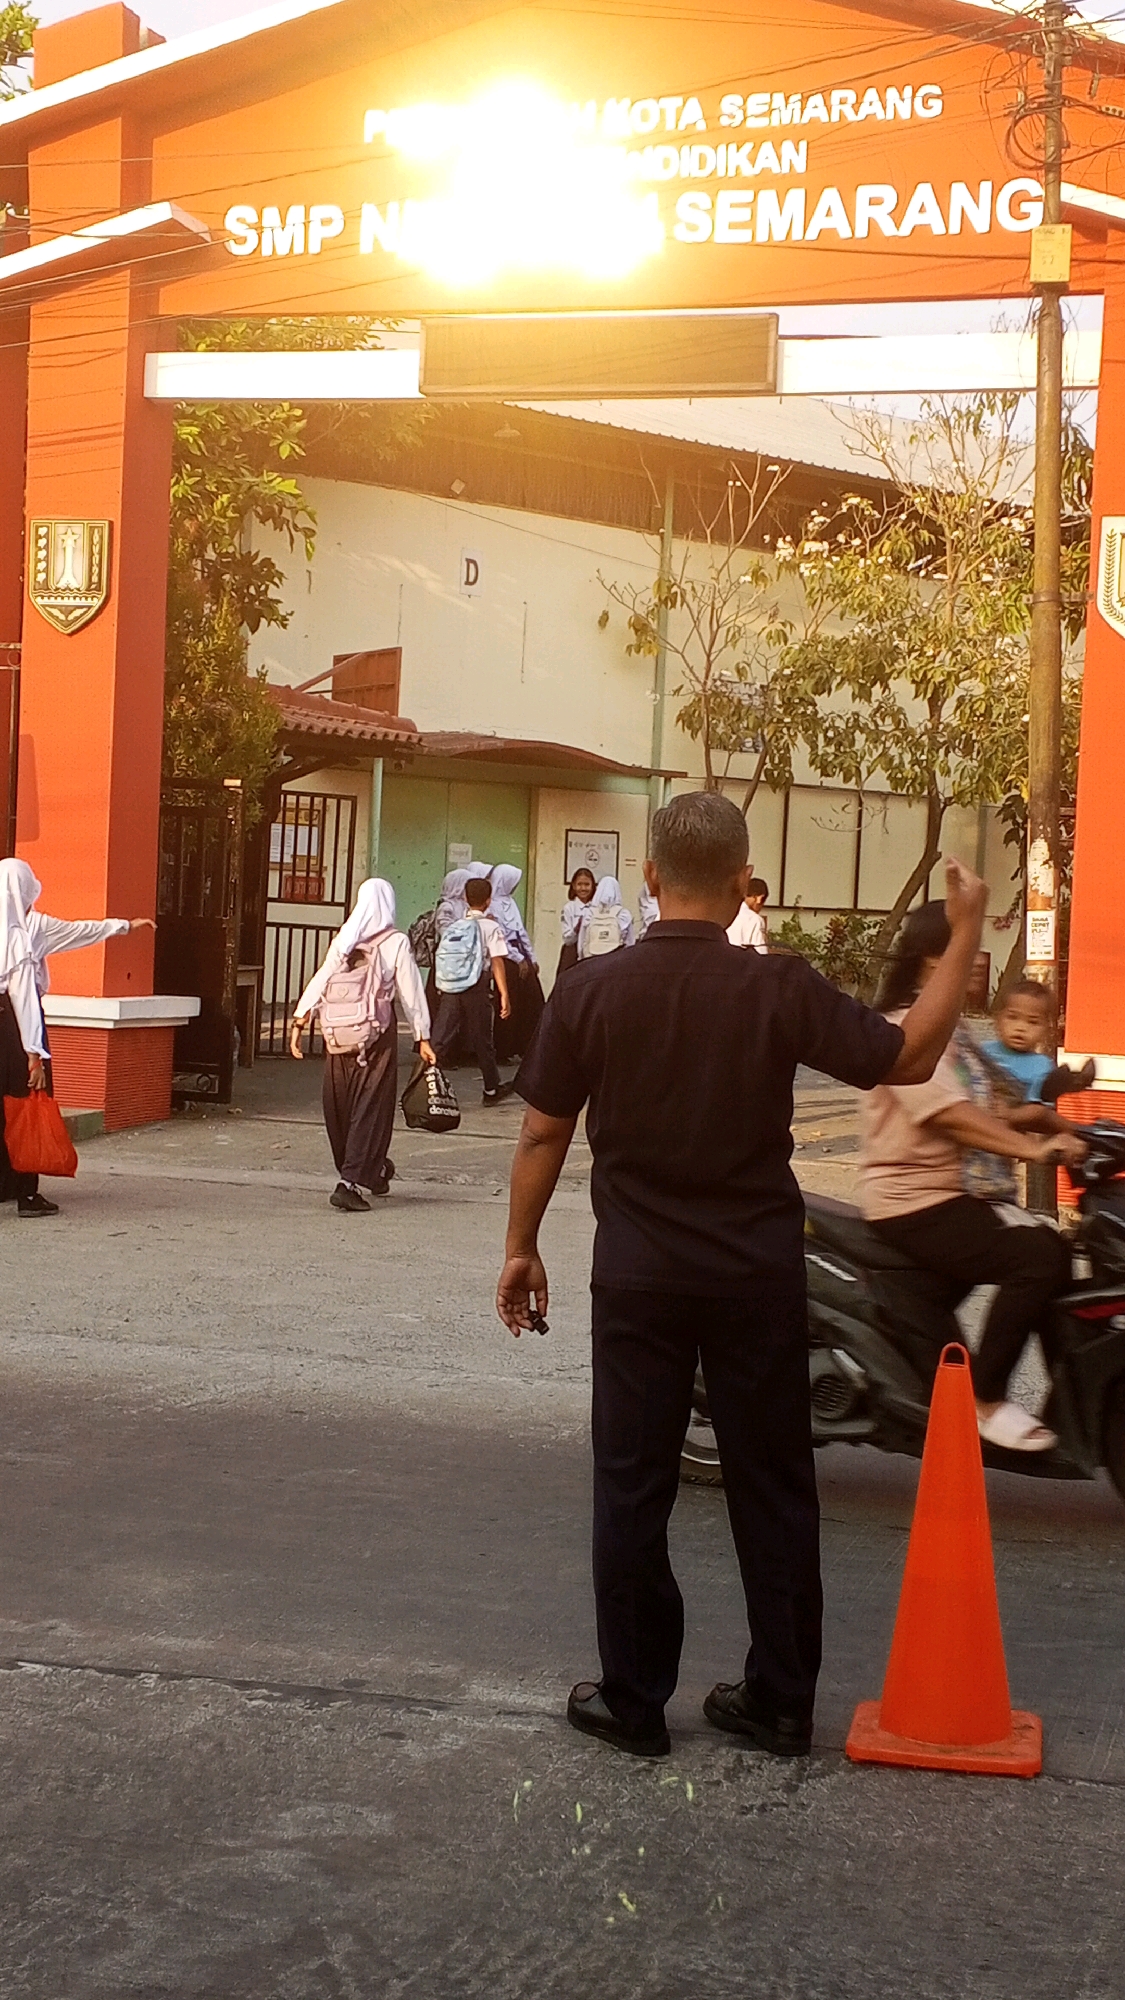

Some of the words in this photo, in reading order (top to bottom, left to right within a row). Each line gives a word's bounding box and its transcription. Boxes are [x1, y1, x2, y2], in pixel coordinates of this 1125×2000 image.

[602, 97, 706, 135] KOTA
[719, 84, 943, 127] SEMARANG
[224, 204, 345, 256] SMP
[673, 177, 1045, 243] SEMARANG
[464, 557, 479, 586] D
